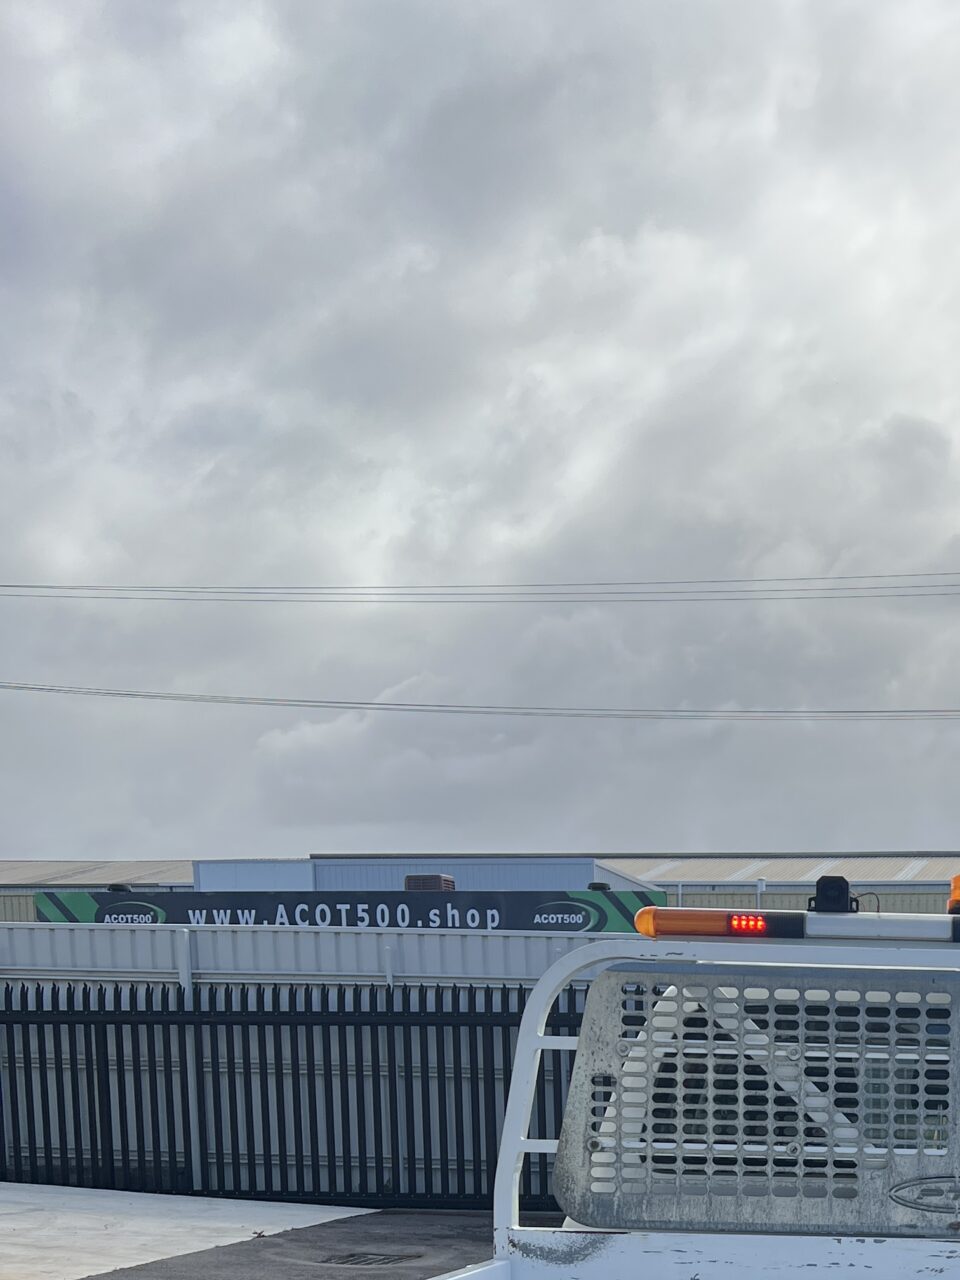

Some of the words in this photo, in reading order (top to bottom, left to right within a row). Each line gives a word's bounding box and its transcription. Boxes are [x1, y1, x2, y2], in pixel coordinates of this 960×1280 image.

[103, 913, 153, 924] ACOT500
[187, 902, 500, 930] www.ACOT500.shop
[533, 913, 583, 924] ACOT500
